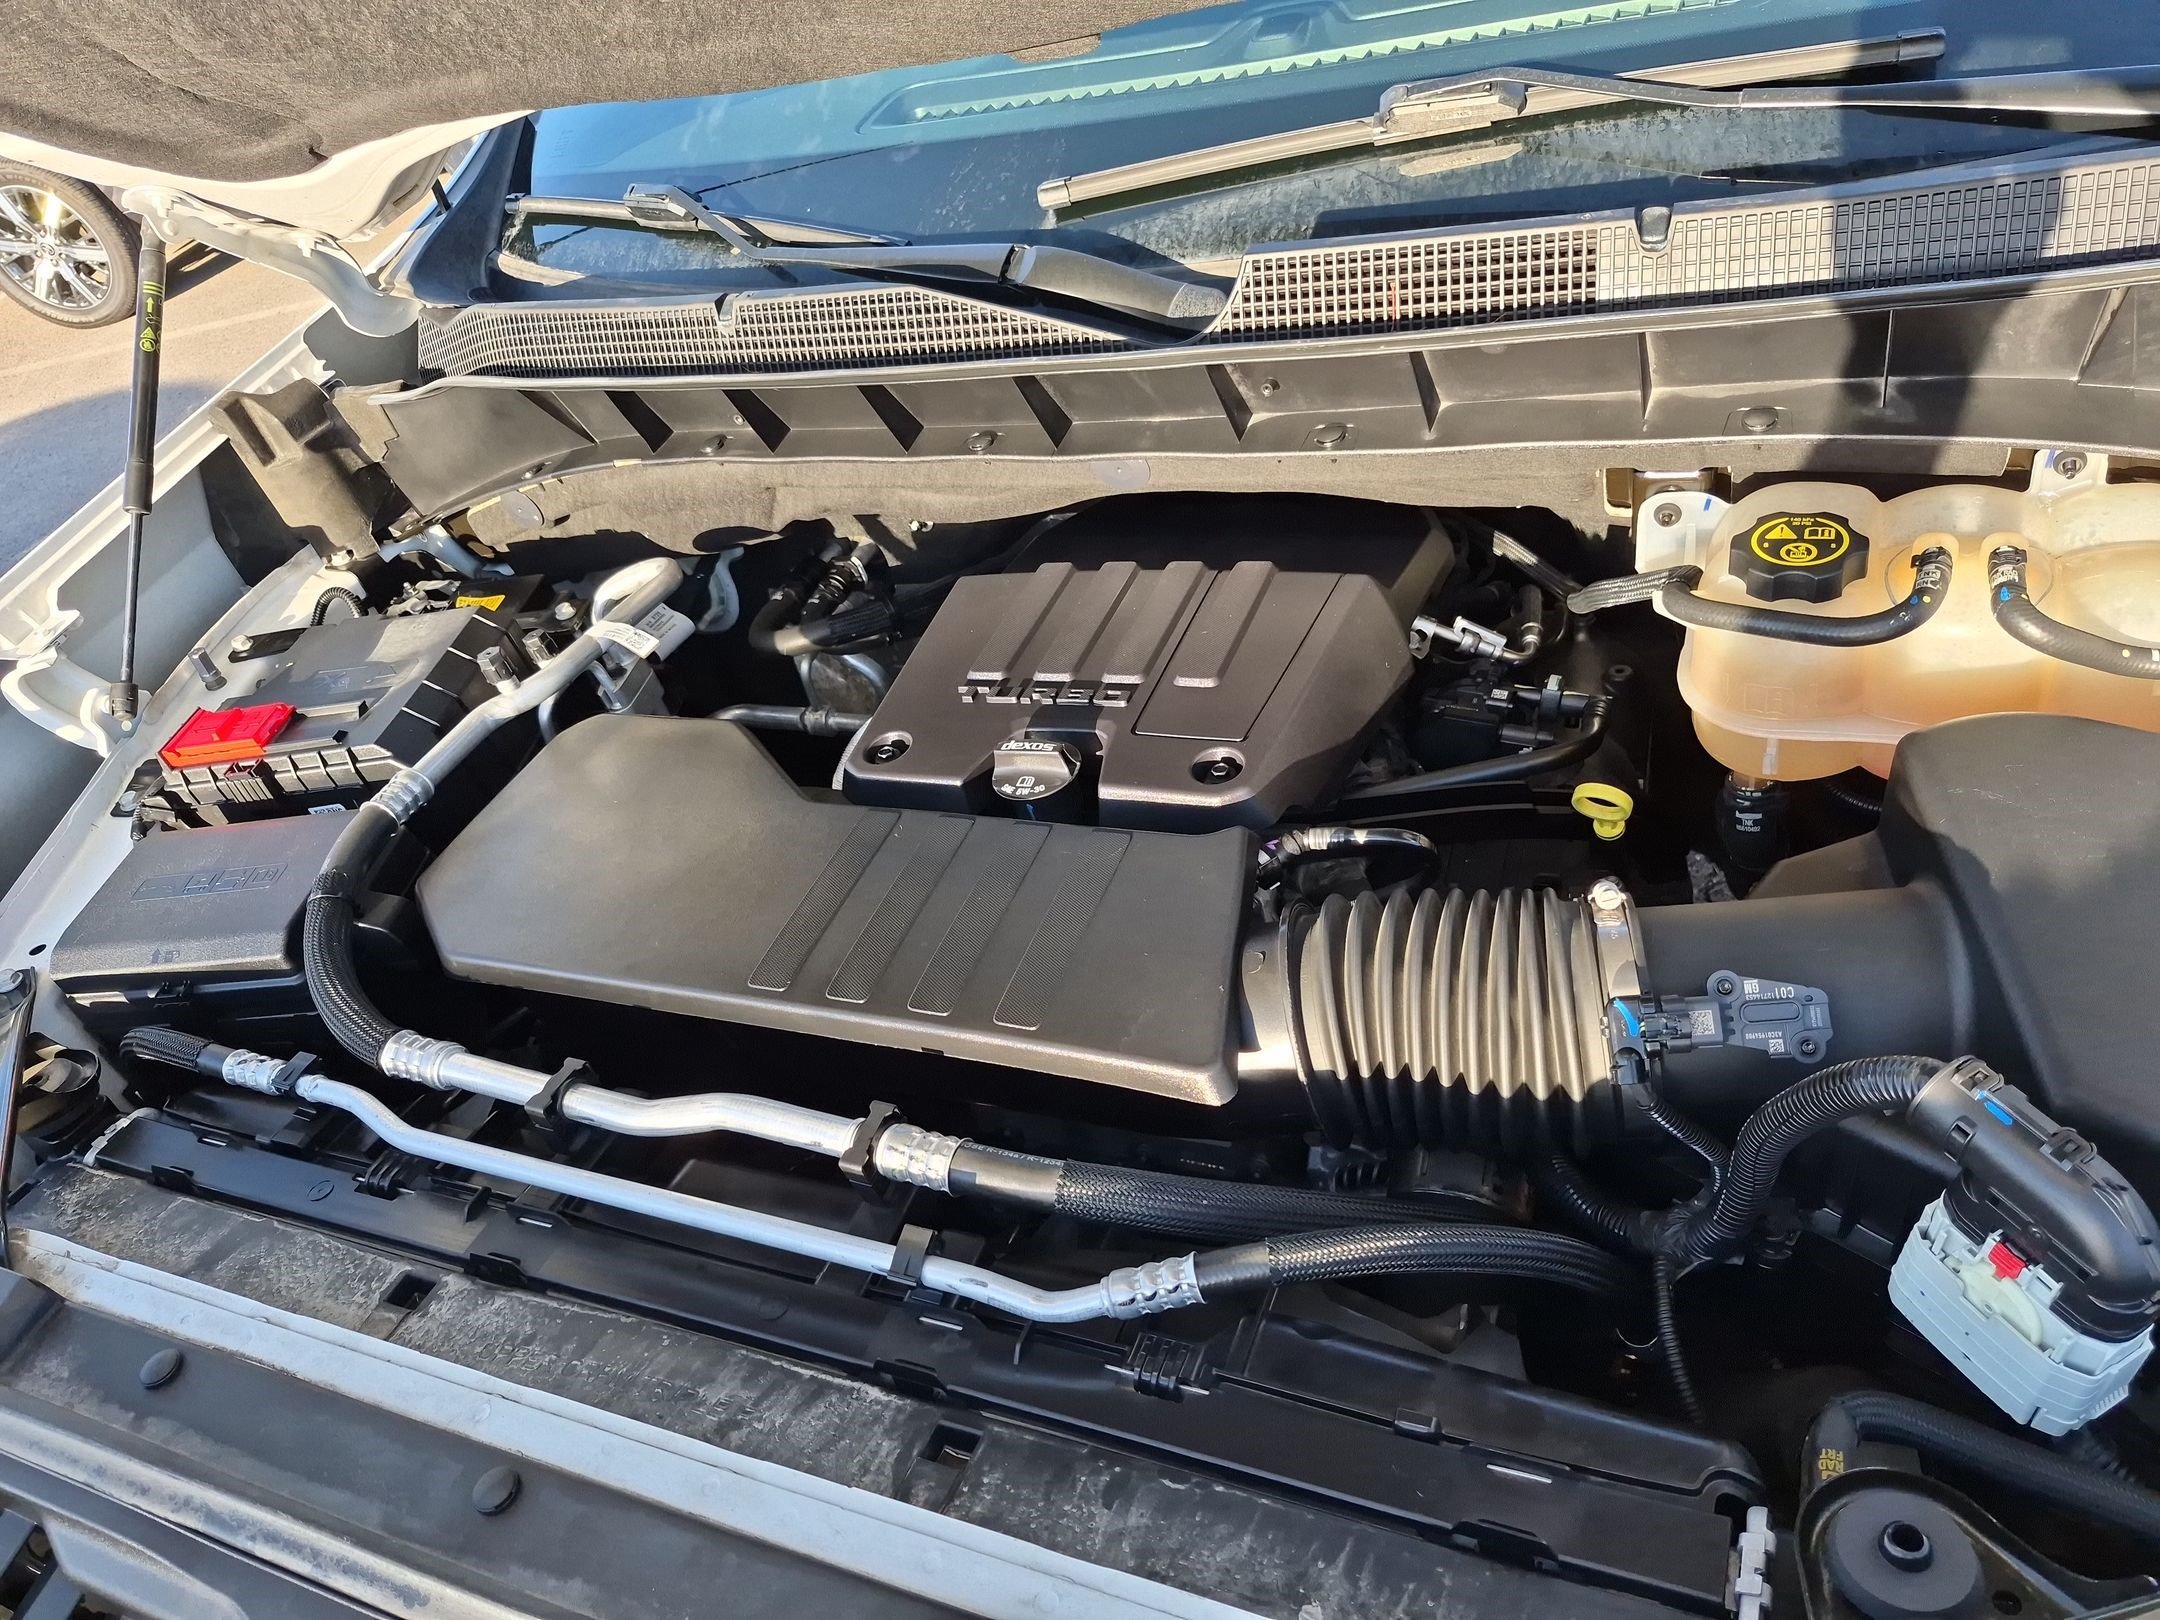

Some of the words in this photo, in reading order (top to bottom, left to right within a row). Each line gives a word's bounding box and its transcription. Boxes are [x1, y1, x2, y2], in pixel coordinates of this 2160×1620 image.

[958, 685, 1132, 707] TURBO
[1001, 740, 1057, 751] dexos
[1001, 783, 1016, 794] SAE
[1015, 785, 1046, 796] 5W-30
[1743, 980, 1760, 994] GM
[1819, 1448, 1844, 1461] FRT
[1819, 1460, 1844, 1473] RAD
